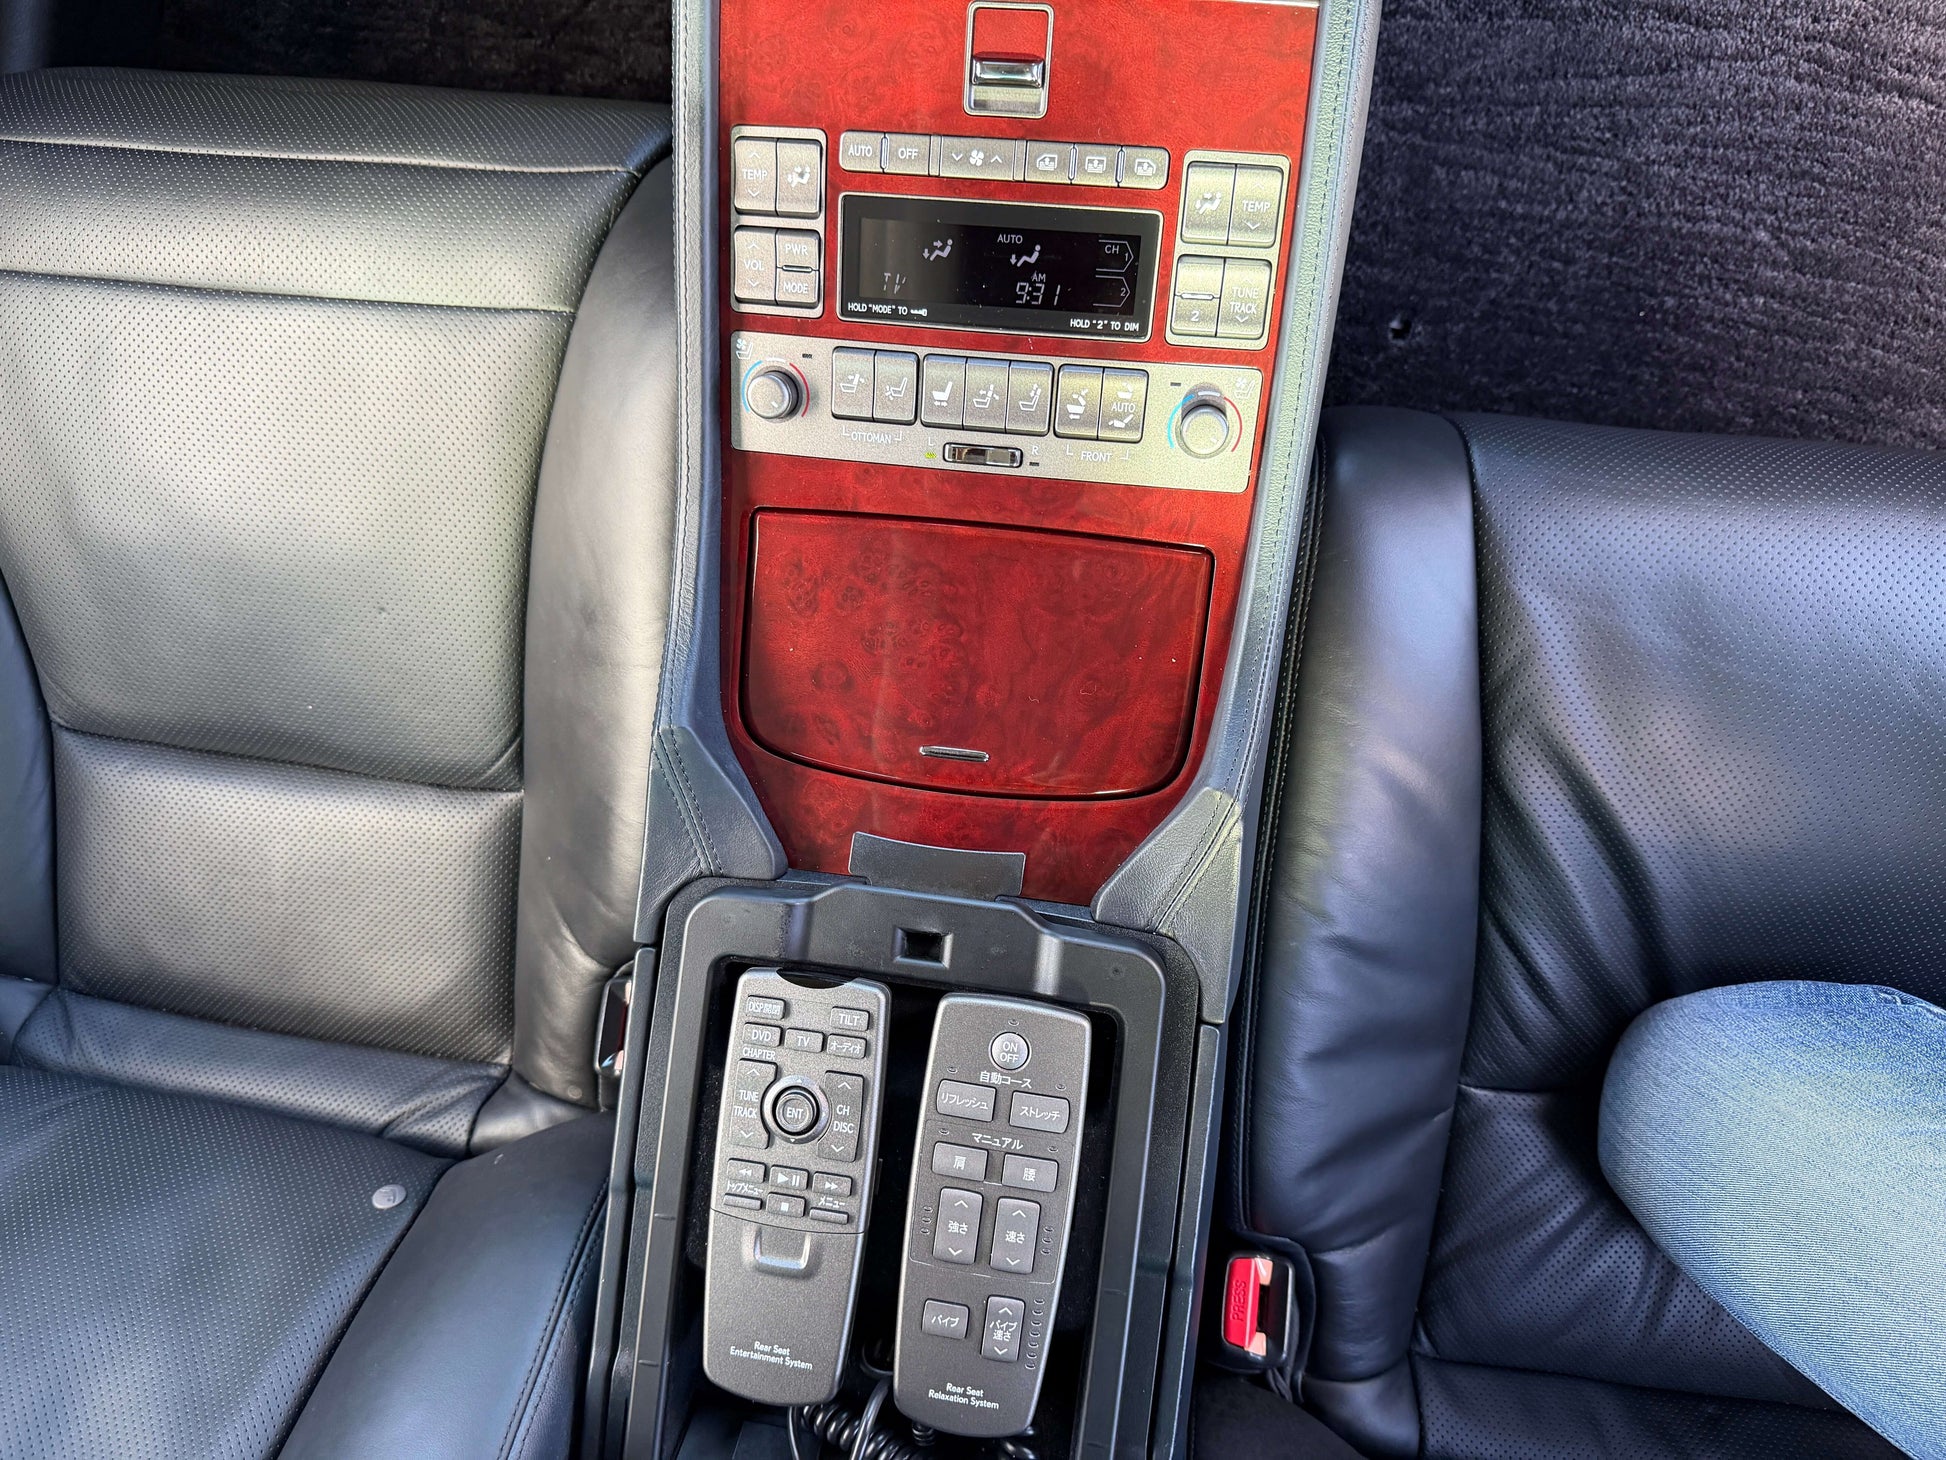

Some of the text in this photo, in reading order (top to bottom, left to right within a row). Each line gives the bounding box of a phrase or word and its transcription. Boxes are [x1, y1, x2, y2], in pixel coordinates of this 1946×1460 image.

[848, 144, 873, 157] AUTO
[898, 148, 918, 160] OFF
[742, 168, 768, 181] TEMP
[1241, 199, 1271, 214] TEMP
[997, 233, 1023, 245] AUTO
[785, 243, 808, 256] PWR
[1104, 244, 1120, 255] CH
[743, 258, 764, 271] VOL
[1032, 272, 1047, 283] AM
[783, 281, 809, 295] MODE
[1015, 281, 1062, 307] 9:31
[1120, 287, 1127, 297] 2
[1231, 286, 1260, 299] TUNE
[848, 302, 909, 316] HOLD "MODE" TO
[1229, 301, 1258, 315] TRACK
[1190, 310, 1200, 322] 2
[1070, 318, 1140, 332] HOLD "2" TO DIM
[1111, 402, 1136, 413] AUTO
[850, 431, 892, 445] OTTOMAN
[927, 436, 935, 446] L
[1031, 445, 1040, 456] R
[1080, 450, 1113, 463] FRONT
[838, 1013, 860, 1026] TILT
[751, 1031, 772, 1042] DVD
[797, 1036, 811, 1047] TV
[830, 1041, 862, 1055] オーディオ
[1002, 1041, 1018, 1052] ON
[742, 1047, 776, 1061] CHAPTER
[1000, 1053, 1019, 1064] OFF
[979, 1070, 1033, 1089] 自動コース
[738, 1089, 759, 1102] TUNE
[941, 1093, 989, 1110] リフレッシュ
[733, 1105, 758, 1119] TRACK
[786, 1108, 804, 1120] ENT
[836, 1104, 850, 1117] CH
[1019, 1105, 1062, 1121] ストレッチ
[833, 1121, 855, 1134] DISC
[971, 1132, 1024, 1150] マニュアル
[953, 1155, 966, 1171] 肩
[1022, 1167, 1037, 1182] 腰
[818, 1196, 846, 1209] メニュー
[948, 1220, 969, 1236] 強さ
[1005, 1229, 1025, 1245] 速さ
[1229, 1279, 1247, 1322] PRESS
[993, 1329, 1012, 1342] 速さ
[753, 1341, 790, 1356] Rear Seat
[730, 1346, 813, 1371] Entertainment System
[946, 1382, 984, 1398] Rear Seat
[928, 1389, 1000, 1411] Relaxation System
